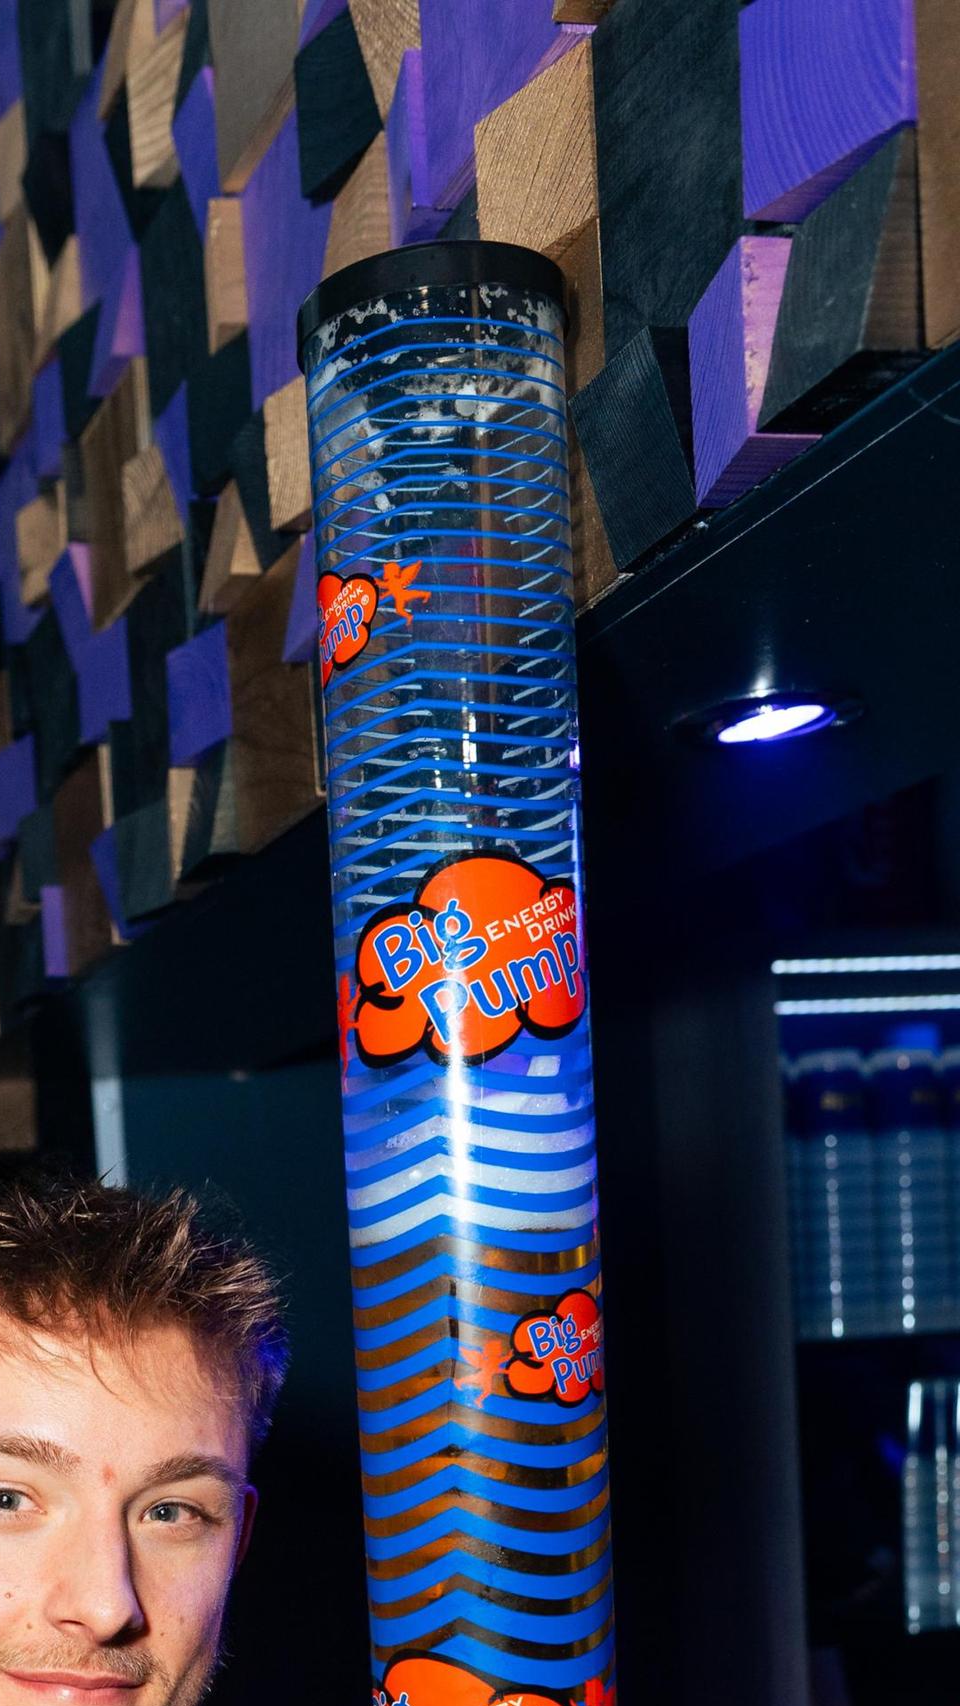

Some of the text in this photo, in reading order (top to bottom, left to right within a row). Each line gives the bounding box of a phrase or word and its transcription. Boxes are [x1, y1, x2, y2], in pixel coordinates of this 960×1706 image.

[324, 580, 353, 621] ENERGY
[335, 584, 363, 617] DRINK
[320, 603, 364, 664] ump
[485, 889, 566, 942] ENERGY
[526, 903, 578, 943] DRINK
[373, 899, 489, 992] Big
[418, 931, 581, 1044] Pump
[527, 1312, 582, 1359] Big
